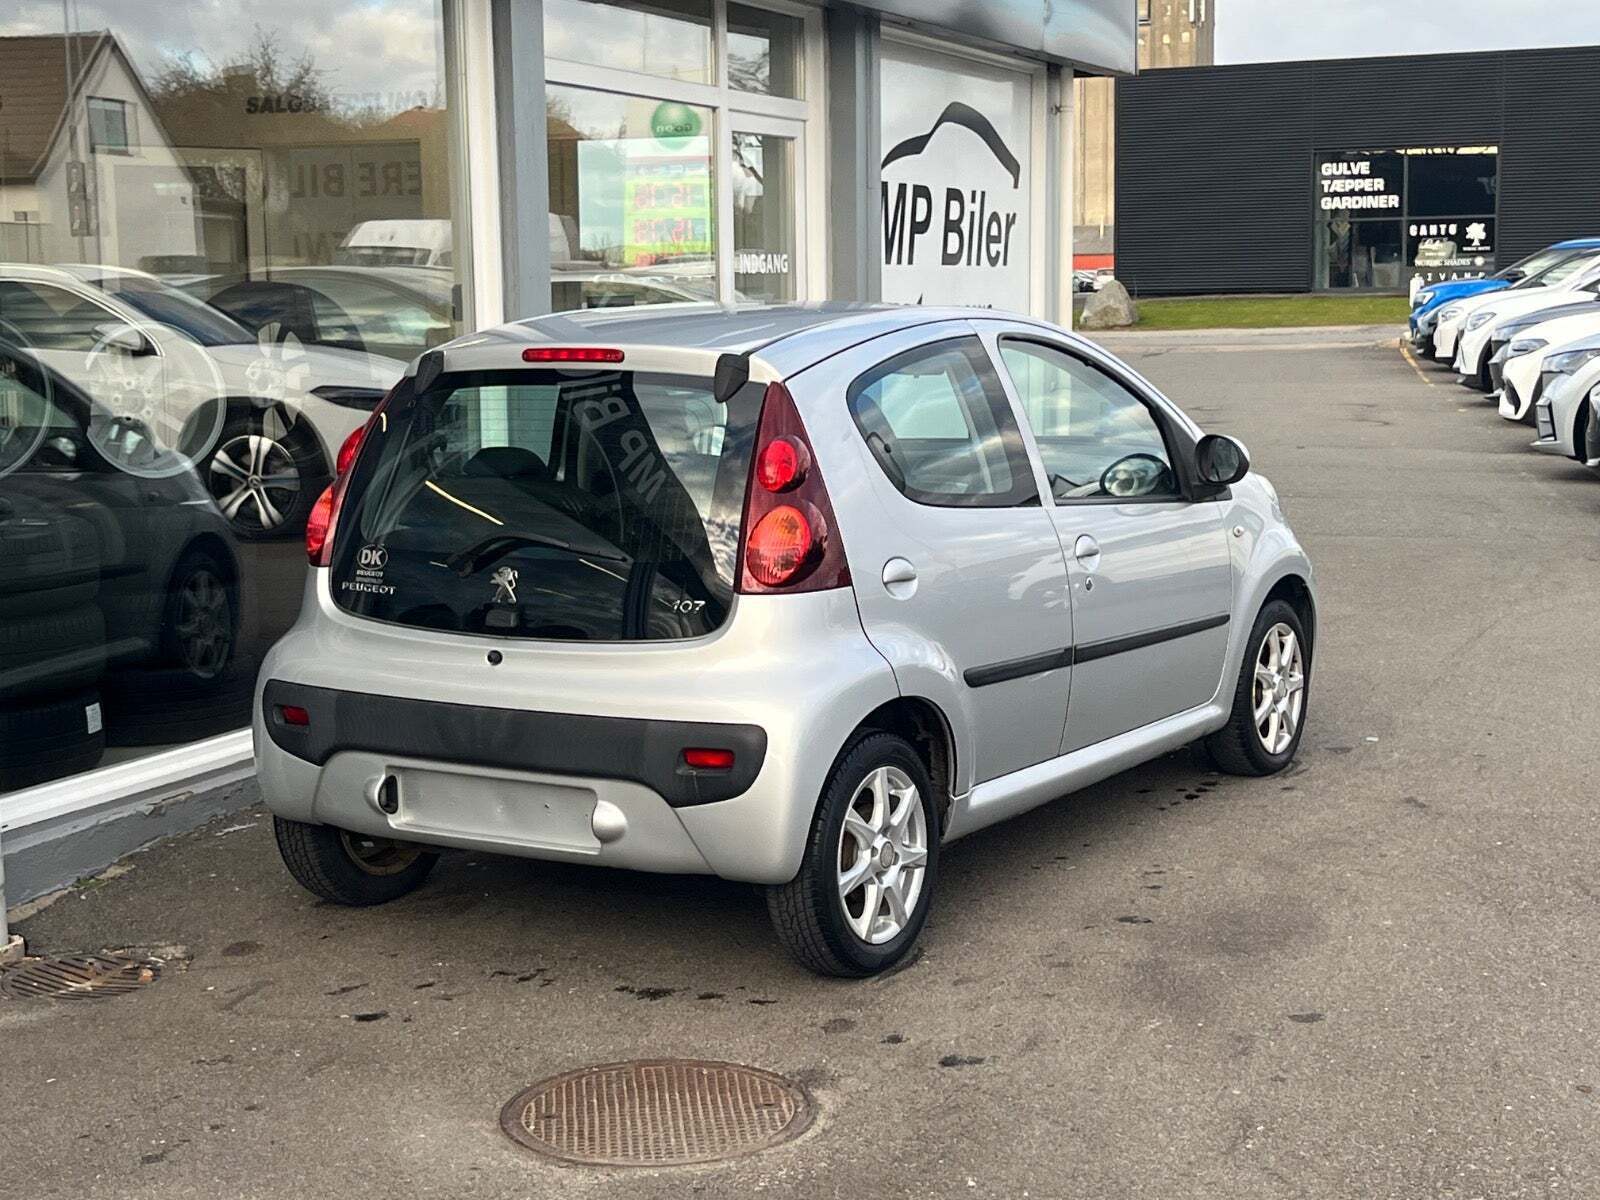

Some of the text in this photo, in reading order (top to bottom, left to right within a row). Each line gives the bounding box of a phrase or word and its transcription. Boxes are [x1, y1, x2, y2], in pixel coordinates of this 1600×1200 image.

[1321, 161, 1371, 176] GULVE
[1321, 178, 1385, 193] TÆPPER
[1320, 195, 1400, 210] GARDINER
[881, 181, 1017, 268] MP Biler
[739, 253, 789, 274] INDGANG
[361, 549, 383, 566] DK
[341, 581, 397, 595] PEUGEOT
[672, 599, 706, 614] 107
